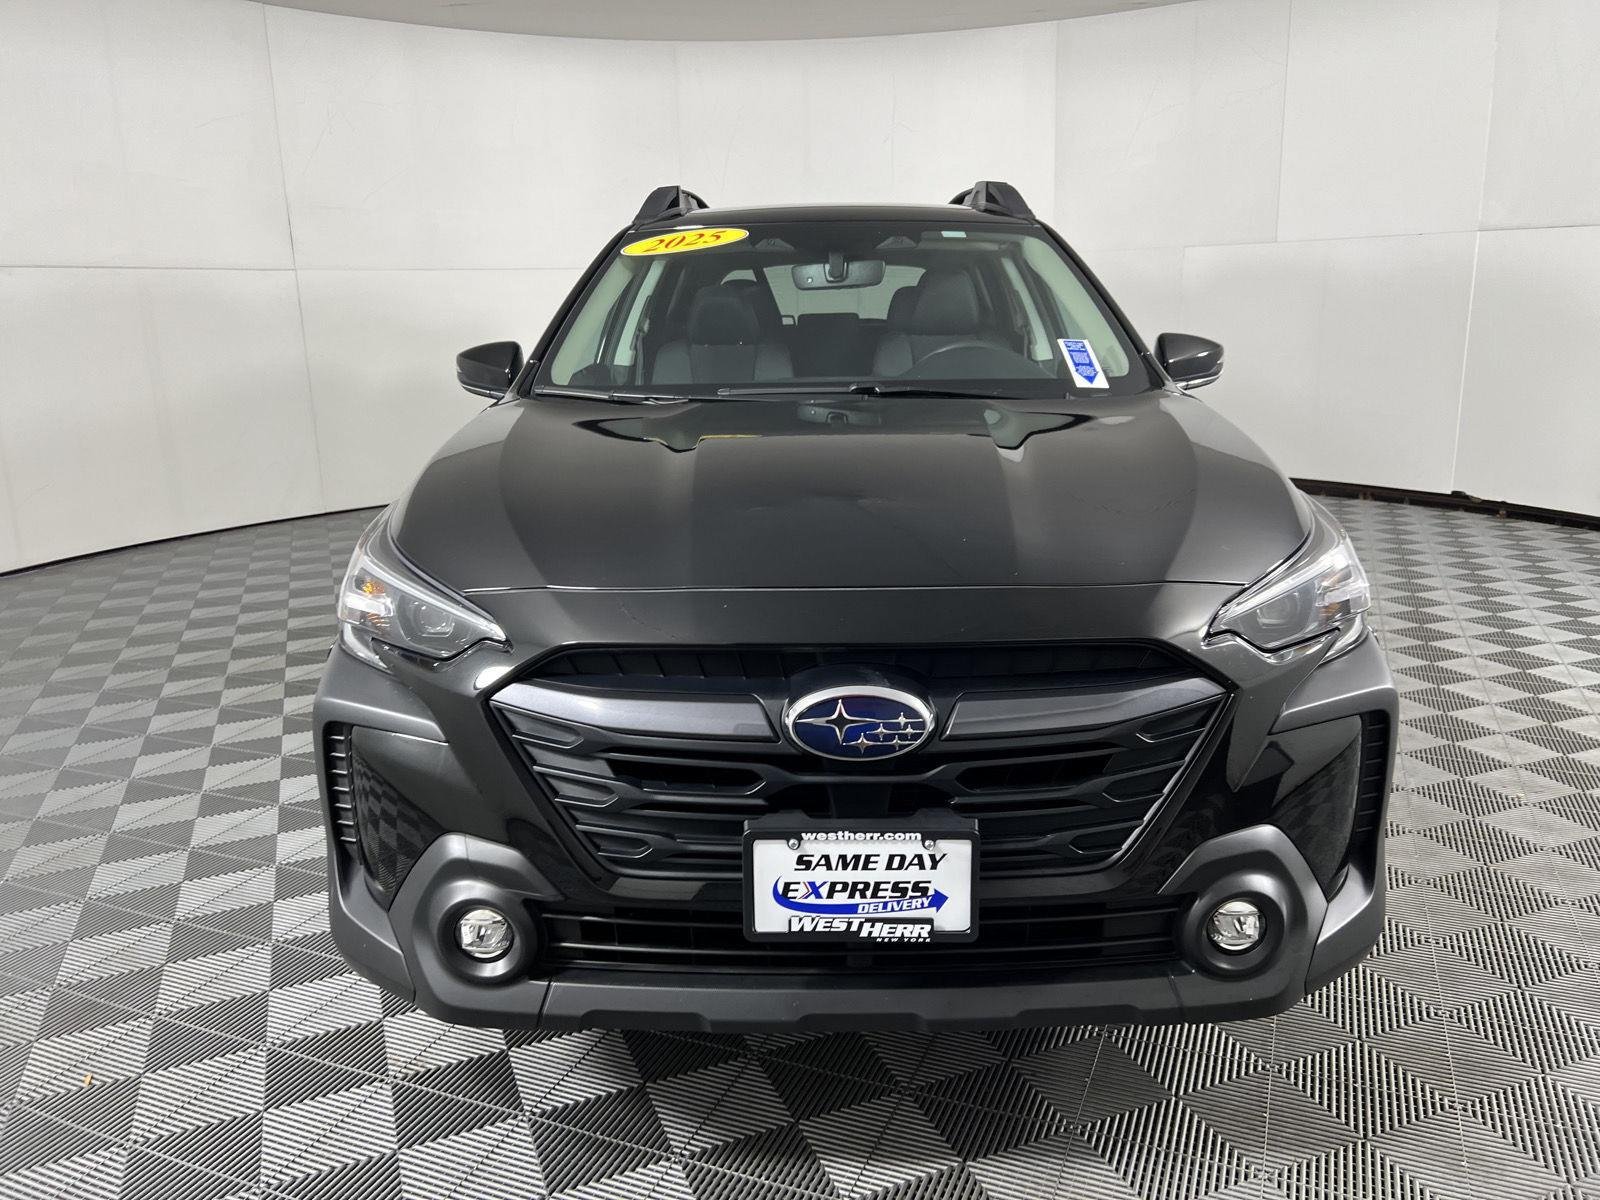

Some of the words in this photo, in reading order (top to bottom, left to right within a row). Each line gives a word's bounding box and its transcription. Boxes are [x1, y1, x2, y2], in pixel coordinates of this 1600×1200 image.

[642, 230, 727, 253] 2025
[801, 830, 922, 841] westherr.com
[794, 853, 880, 871] SAME
[885, 853, 948, 871] DAY
[781, 880, 932, 899] EXPRESS
[857, 896, 933, 914] DELIVERY
[789, 916, 866, 933] WEST
[859, 922, 932, 938] HERR
